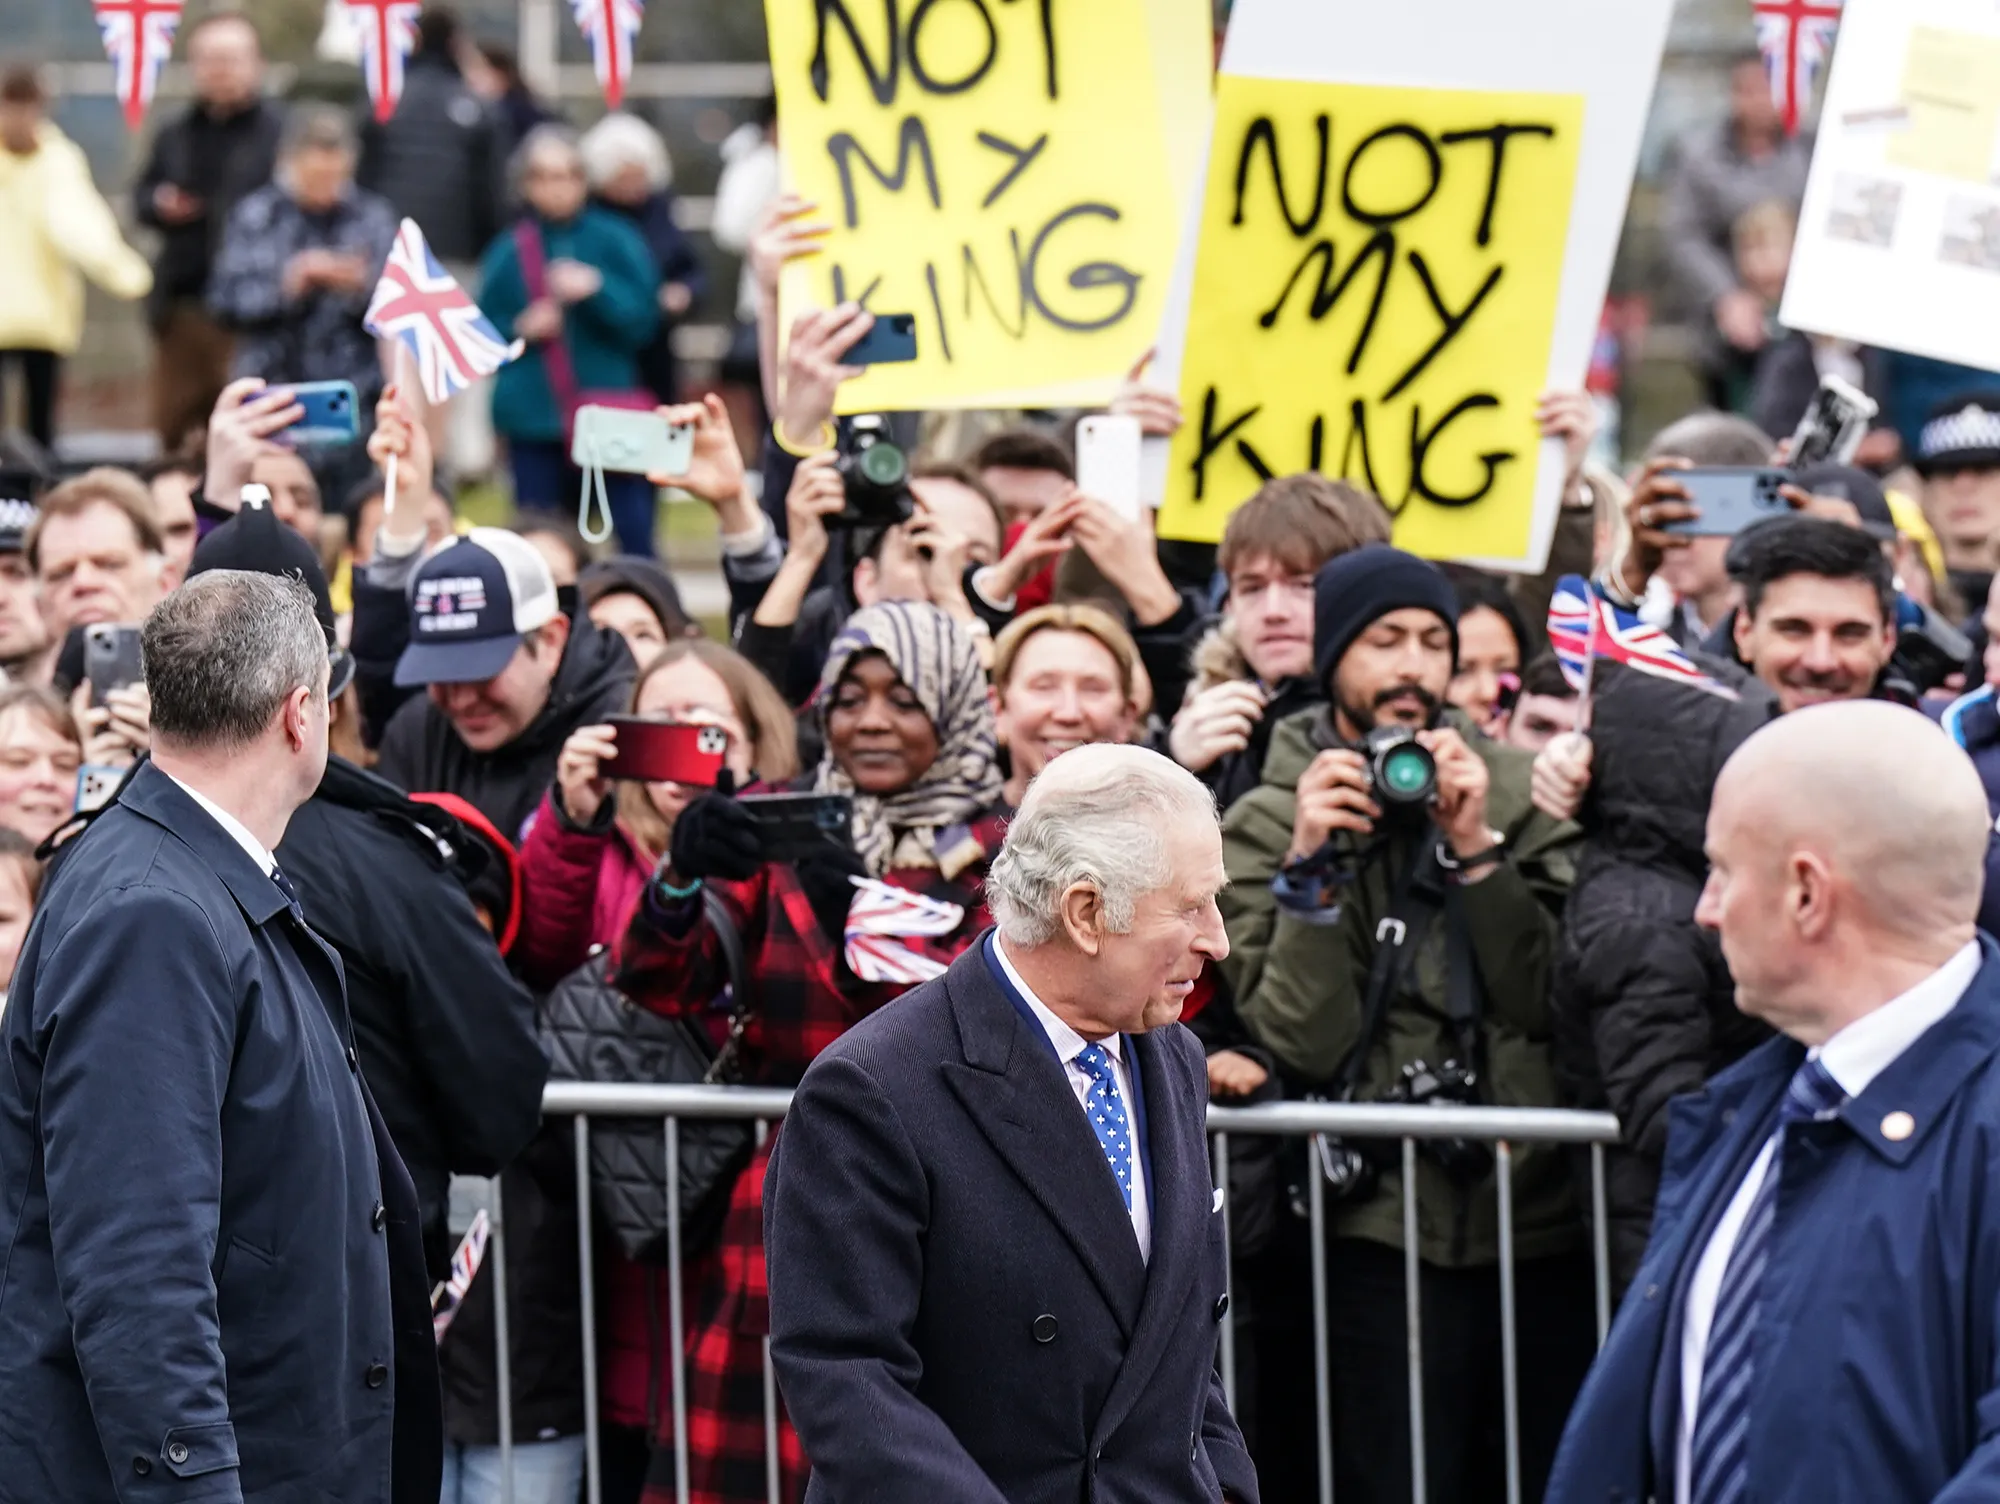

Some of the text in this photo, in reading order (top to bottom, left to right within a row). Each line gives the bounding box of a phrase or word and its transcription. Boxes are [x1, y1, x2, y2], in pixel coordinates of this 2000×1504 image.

[826, 114, 1048, 230] MY
[1230, 114, 1556, 246] NOT
[1258, 228, 1504, 403] MY
[1190, 385, 1517, 521] KING
